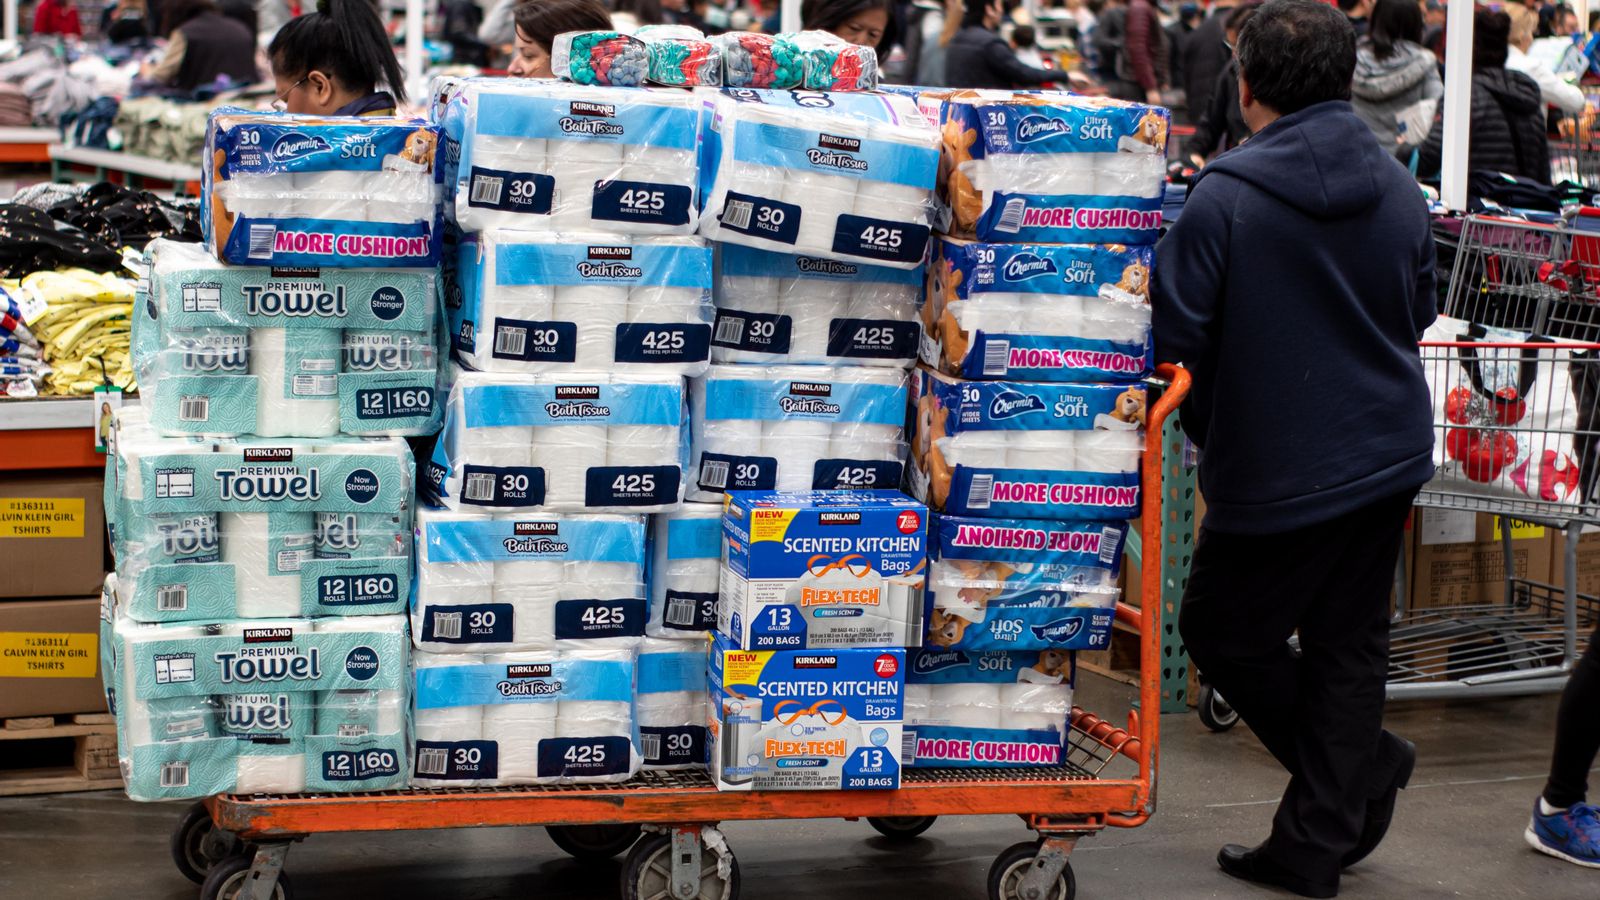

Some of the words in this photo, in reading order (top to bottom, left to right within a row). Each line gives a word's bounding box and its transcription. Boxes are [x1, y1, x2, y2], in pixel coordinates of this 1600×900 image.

[572, 102, 614, 113] KIRKLAND
[988, 112, 1006, 126] 30
[1085, 117, 1108, 126] Ultra
[1020, 118, 1059, 137] Charmin
[1080, 124, 1113, 140] Soft
[241, 131, 260, 145] 30
[821, 135, 859, 148] KIRKLAND
[277, 137, 318, 157] Charmin
[341, 143, 376, 159] Soft
[509, 180, 536, 198] 30
[510, 196, 533, 205] ROLLS
[620, 189, 665, 210] 425
[757, 206, 784, 225] 30
[1023, 209, 1072, 227] MORE
[757, 222, 779, 232] ROLLS
[275, 231, 333, 254] MORE
[860, 226, 902, 247] 425
[590, 247, 630, 256] KIRKLAND
[978, 250, 995, 264] 30
[1009, 258, 1048, 275] Charmin
[1071, 259, 1092, 269] Ultra
[1063, 267, 1096, 284] Soft
[268, 282, 321, 291] PREMIUM
[243, 285, 344, 316] Towel
[379, 293, 397, 301] Now
[372, 301, 403, 310] Stronger
[750, 321, 775, 337] 30
[853, 328, 894, 344] 425
[533, 329, 559, 346] 30
[642, 331, 684, 349] 425
[1010, 350, 1062, 367] MORE
[557, 386, 598, 395] KIRKLAND
[792, 383, 830, 392] KIRKLAND
[962, 388, 980, 402] 30
[360, 392, 384, 408] 12
[392, 391, 430, 408] 160
[994, 396, 1034, 414] Charmin
[1060, 394, 1083, 403] Ultra
[1054, 402, 1088, 417] Soft
[246, 449, 291, 457] KIRKLAND
[240, 467, 296, 475] PREMIUM
[735, 464, 760, 480] 30
[837, 467, 876, 485] 425
[217, 469, 319, 499] Towel
[353, 476, 371, 484] Now
[502, 474, 529, 491] 30
[612, 474, 655, 492] 425
[346, 484, 377, 493] Stronger
[993, 483, 1047, 502] MORE
[1050, 484, 1138, 506] CUSHIONY
[10, 502, 55, 511] #1363111
[25, 513, 51, 521] KLEIN
[54, 513, 75, 521] GIRL
[820, 513, 860, 521] KIRKLAND
[898, 515, 907, 529] 7
[13, 526, 51, 534] TSHIRTS
[516, 523, 556, 531] KIRKLAND
[784, 538, 852, 553] SCENTED
[856, 537, 920, 552] KITCHEN
[955, 526, 1046, 550] CUSHIONY
[1050, 532, 1100, 553] MORE
[881, 559, 911, 573] Bags
[324, 578, 345, 595] 12
[354, 577, 394, 595] 160
[801, 588, 880, 606] FLEX-TECH
[469, 611, 496, 628] 30
[582, 606, 625, 624] 425
[768, 608, 791, 626] 13
[990, 619, 1023, 632] Soft
[246, 629, 291, 638] KIRKLAND
[757, 636, 775, 645] 200
[776, 636, 800, 645] BAGS
[994, 632, 1017, 642] Ultra
[1089, 634, 1105, 645] 30
[4, 648, 37, 657] CALVIN
[39, 648, 66, 657] KLEIN
[68, 648, 88, 657] GIRL
[241, 647, 297, 656] PREMIUM
[354, 653, 371, 661] Now
[728, 654, 757, 662] NEW
[28, 661, 65, 670] TSHIRTS
[217, 649, 319, 680] Towel
[347, 660, 377, 670] Stronger
[795, 657, 836, 665] KIRKLAND
[876, 659, 884, 672] 7
[918, 651, 958, 668] Charmin
[978, 656, 1012, 671] Soft
[509, 665, 550, 674] KIRKLAND
[759, 682, 828, 696] SCENTED
[832, 681, 898, 696] KITCHEN
[865, 705, 896, 718] Bags
[667, 733, 692, 749] 30
[765, 738, 847, 758] FLEX-TECH
[454, 748, 481, 764] 30
[564, 745, 605, 762] 425
[917, 739, 970, 759] MORE
[328, 754, 350, 770] 12
[358, 752, 394, 771] 160
[859, 750, 883, 767] 13
[849, 779, 867, 787] 200
[869, 778, 892, 786] BAGS
